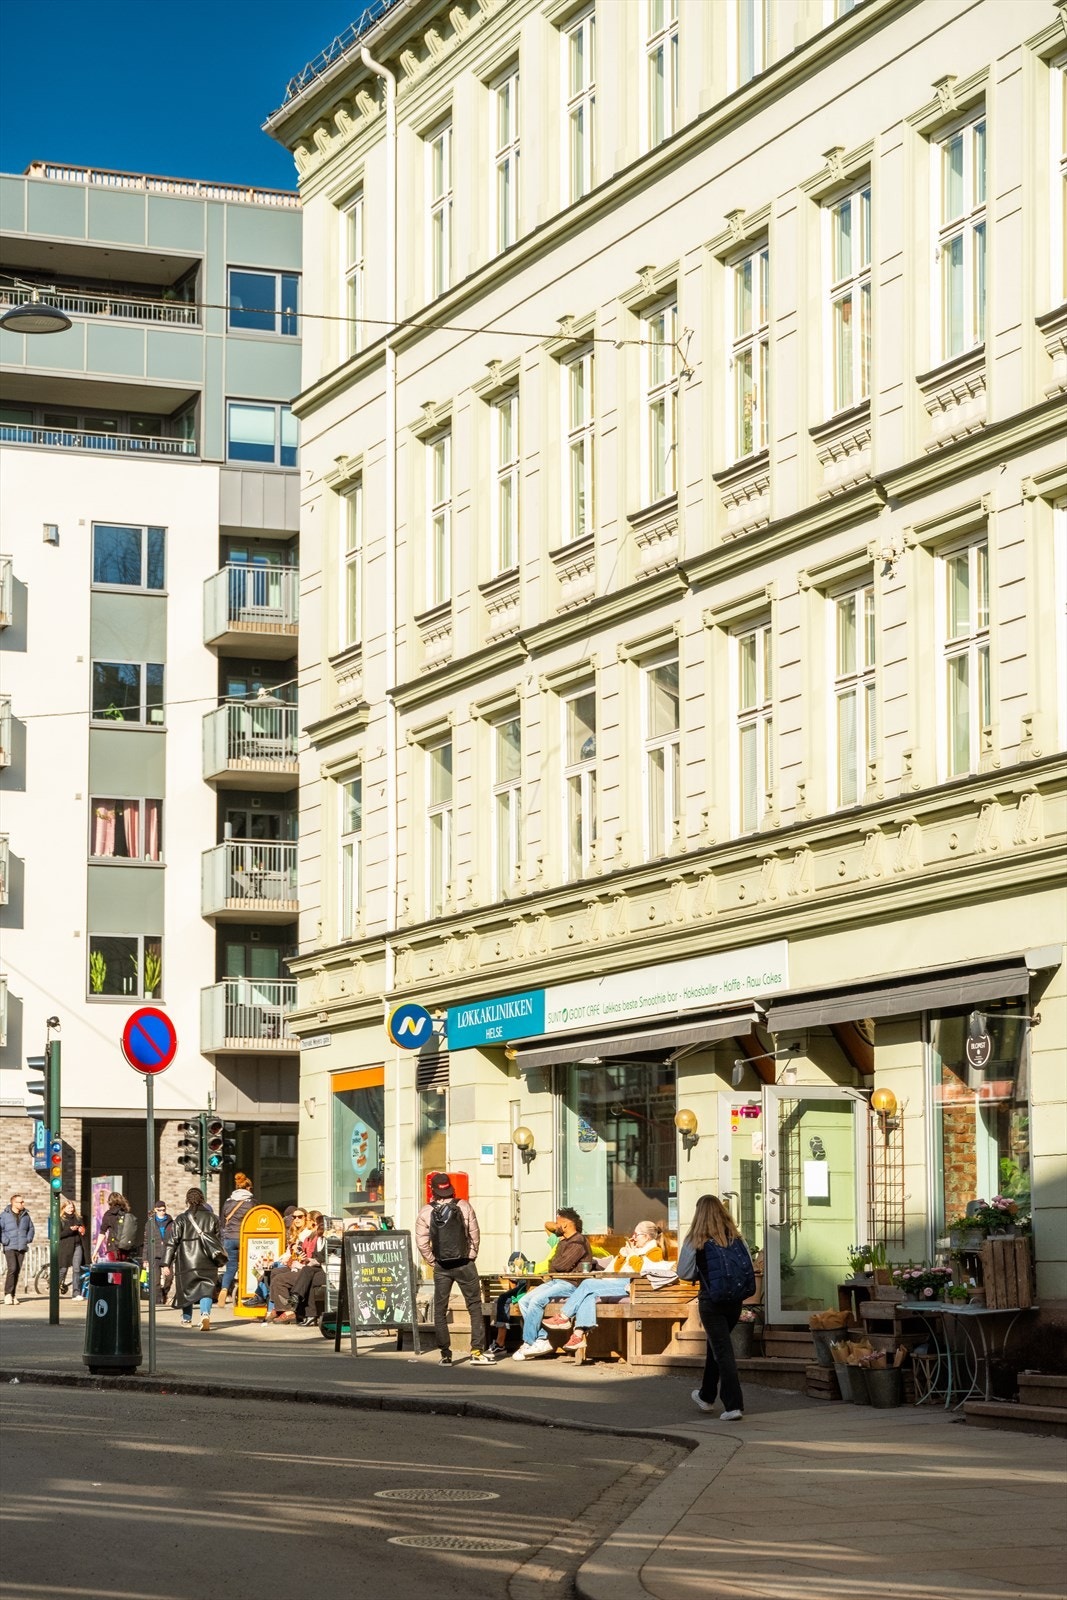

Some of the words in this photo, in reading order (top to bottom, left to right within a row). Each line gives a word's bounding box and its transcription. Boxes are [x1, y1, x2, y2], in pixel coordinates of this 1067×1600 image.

[569, 1006, 585, 1020] GODT
[623, 999, 638, 1010] beste
[638, 992, 666, 1008] Smoothie
[667, 991, 678, 1003] bar
[684, 983, 718, 998] Kokosboller
[723, 978, 741, 992] Kaffe
[746, 975, 761, 988] Raw
[762, 972, 782, 986] Cakes
[457, 998, 533, 1029] LØKKAKLINIKKEN
[485, 1026, 503, 1040] HELSE
[352, 1239, 399, 1253] VELKOMMEN
[355, 1254, 368, 1264] TIL
